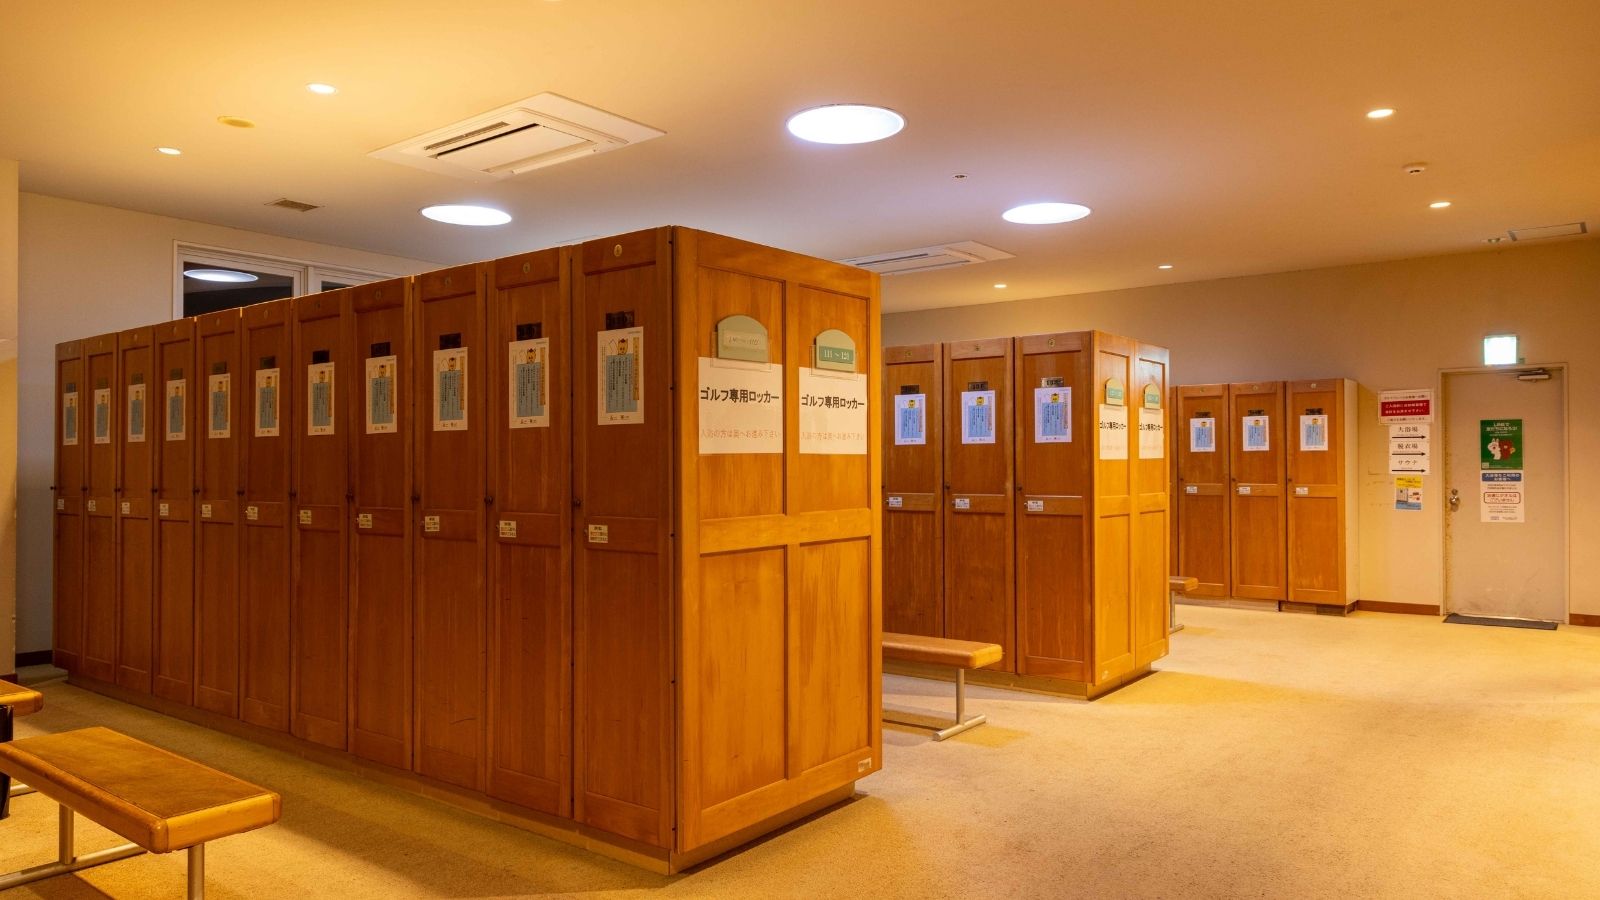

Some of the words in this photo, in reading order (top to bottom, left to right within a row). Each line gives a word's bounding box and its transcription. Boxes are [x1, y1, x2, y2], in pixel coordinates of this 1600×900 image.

[700, 386, 779, 404] ゴルフ専用ロッカー
[801, 394, 865, 410] ゴルフ専用ロッカー
